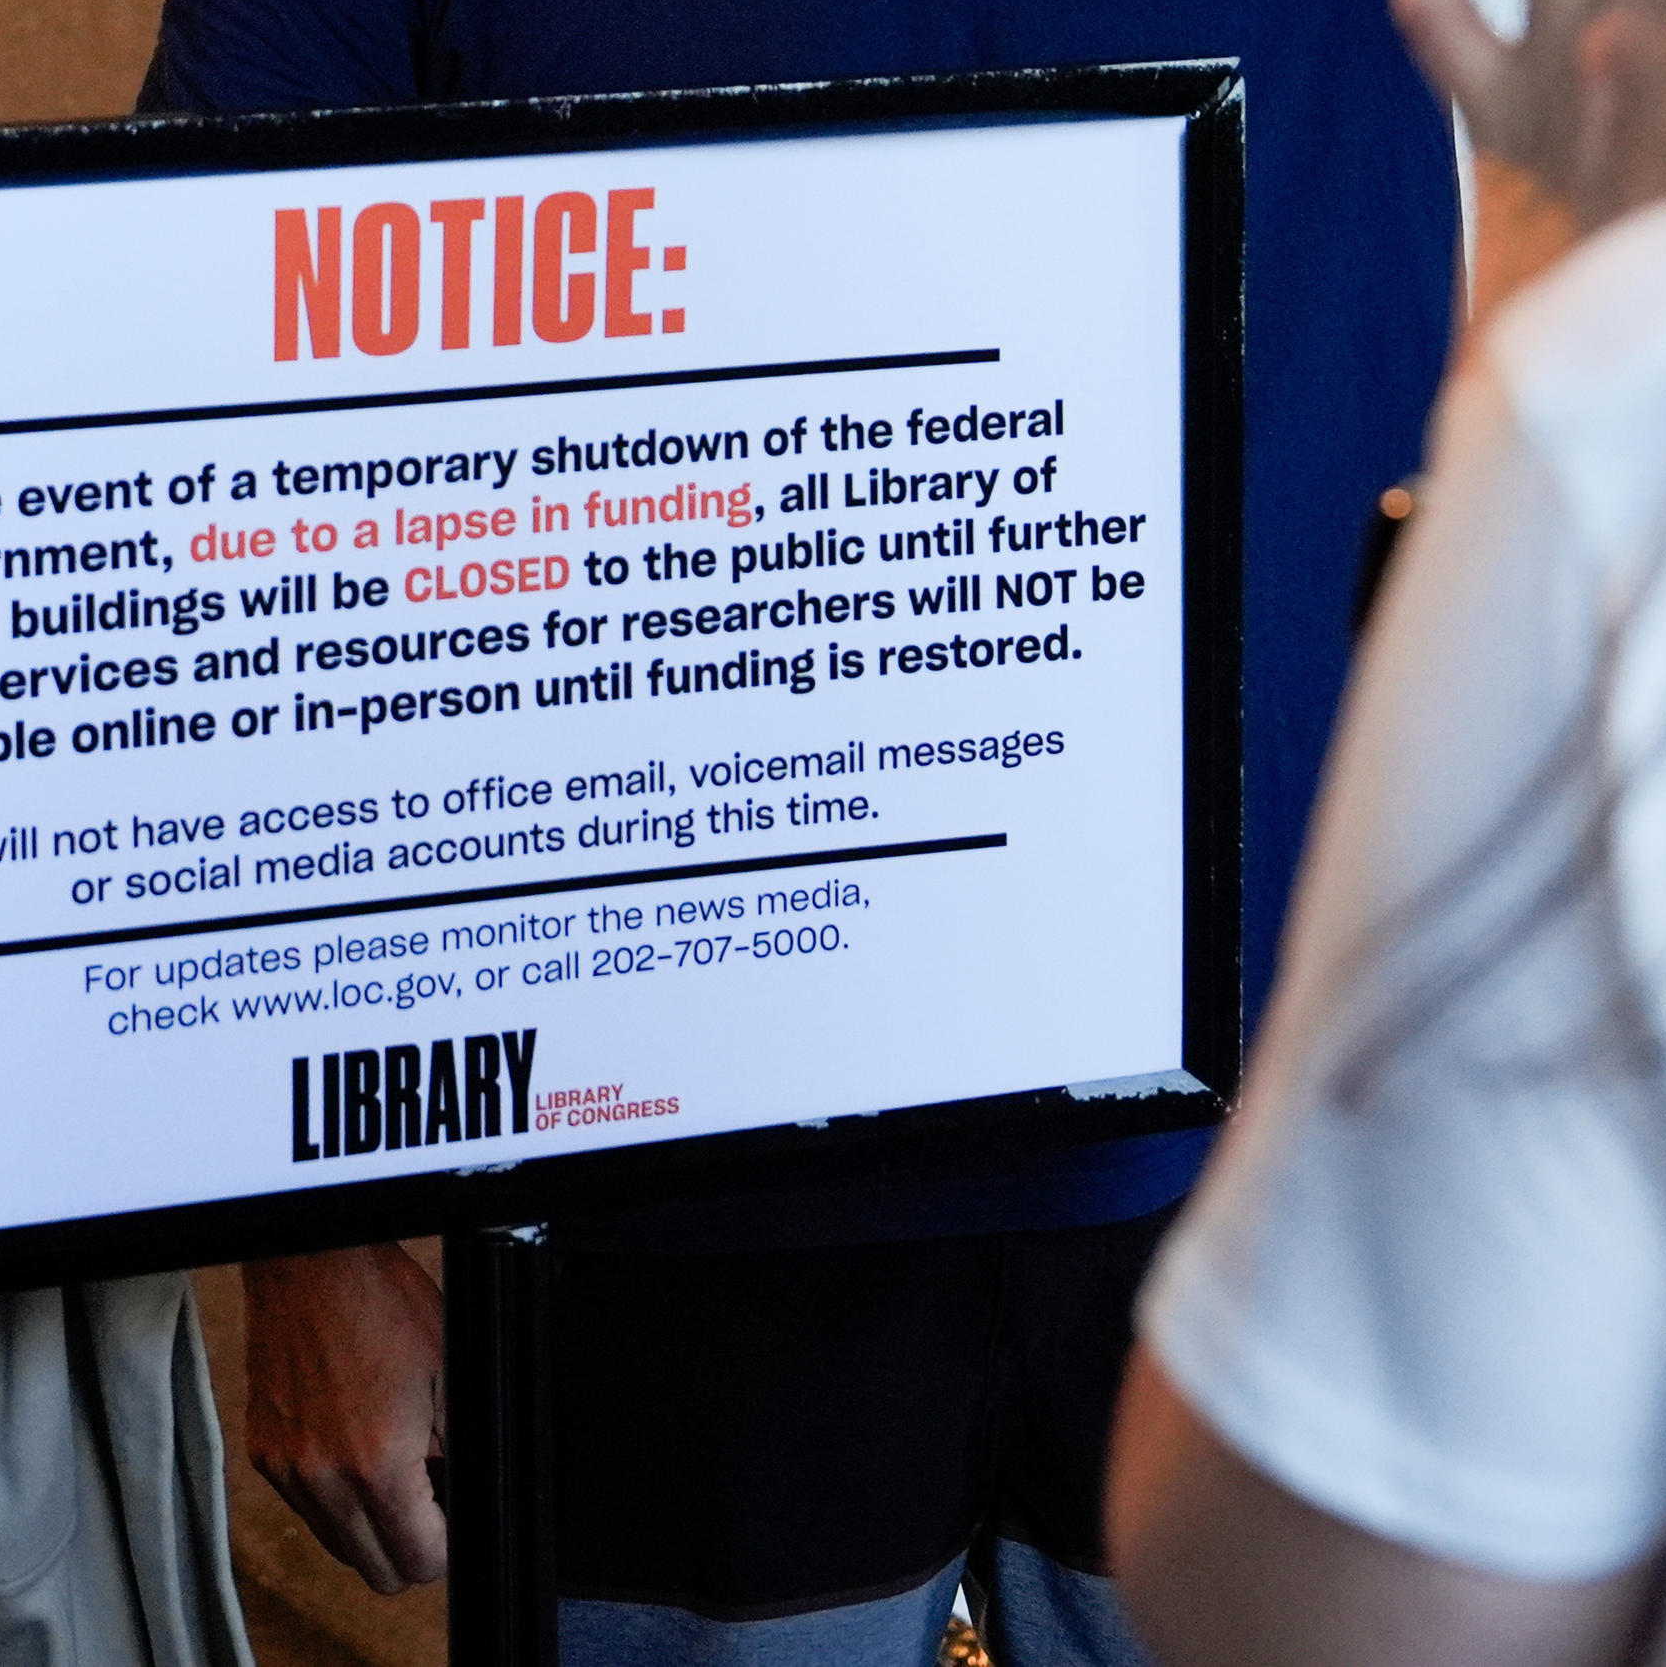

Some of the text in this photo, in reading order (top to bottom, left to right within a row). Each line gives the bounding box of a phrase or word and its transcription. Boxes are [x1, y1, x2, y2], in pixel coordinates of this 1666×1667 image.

[273, 187, 687, 362] NOTICE:
[18, 470, 153, 517] event
[168, 463, 216, 505] of
[230, 470, 257, 500] a
[272, 448, 518, 499] temporary
[532, 428, 749, 475] shutdown
[764, 416, 807, 457] of
[820, 414, 893, 452] the
[906, 399, 1063, 446] federal
[190, 523, 276, 562] due
[291, 518, 338, 553] to
[354, 519, 378, 549] a
[396, 508, 516, 551] lapse
[532, 495, 569, 534] in
[584, 482, 765, 528] funding,
[780, 472, 829, 513] all
[845, 467, 1000, 508] Library
[1013, 455, 1057, 495] of
[12, 587, 226, 639] buildings
[240, 574, 316, 618] will
[333, 571, 389, 610] be
[405, 555, 569, 603] CLOSED
[584, 551, 629, 586] to
[643, 543, 717, 581] the
[732, 528, 865, 584] public
[880, 518, 974, 562] until
[988, 510, 1146, 553] further
[193, 636, 279, 682] and
[296, 622, 530, 673] resources
[543, 609, 608, 649] for
[623, 588, 895, 642] researchers
[908, 574, 980, 616] will
[996, 569, 1077, 609] NOT
[1092, 565, 1145, 601] be
[71, 706, 216, 754] online
[231, 704, 280, 738] or
[295, 681, 520, 735] in-person
[536, 661, 632, 708] until
[647, 648, 816, 697] funding
[829, 642, 865, 680] is
[879, 623, 1082, 676] restored.
[53, 820, 118, 857] not
[133, 815, 225, 848] have
[239, 798, 379, 837] access
[391, 790, 430, 819] to
[443, 775, 552, 814] office
[565, 760, 676, 801] email,
[689, 740, 864, 788] voicemail
[879, 730, 1064, 770] messages
[72, 792, 879, 905] or social media accounts during this time.
[85, 879, 869, 993] For updates please monitor the news media,
[108, 924, 848, 1035] check www.loc.gov, or call 202-707-5000.
[292, 1028, 537, 1163] LIBRARY
[535, 1084, 624, 1111] LIBRARY
[536, 1096, 679, 1131] OF CONGRESS
